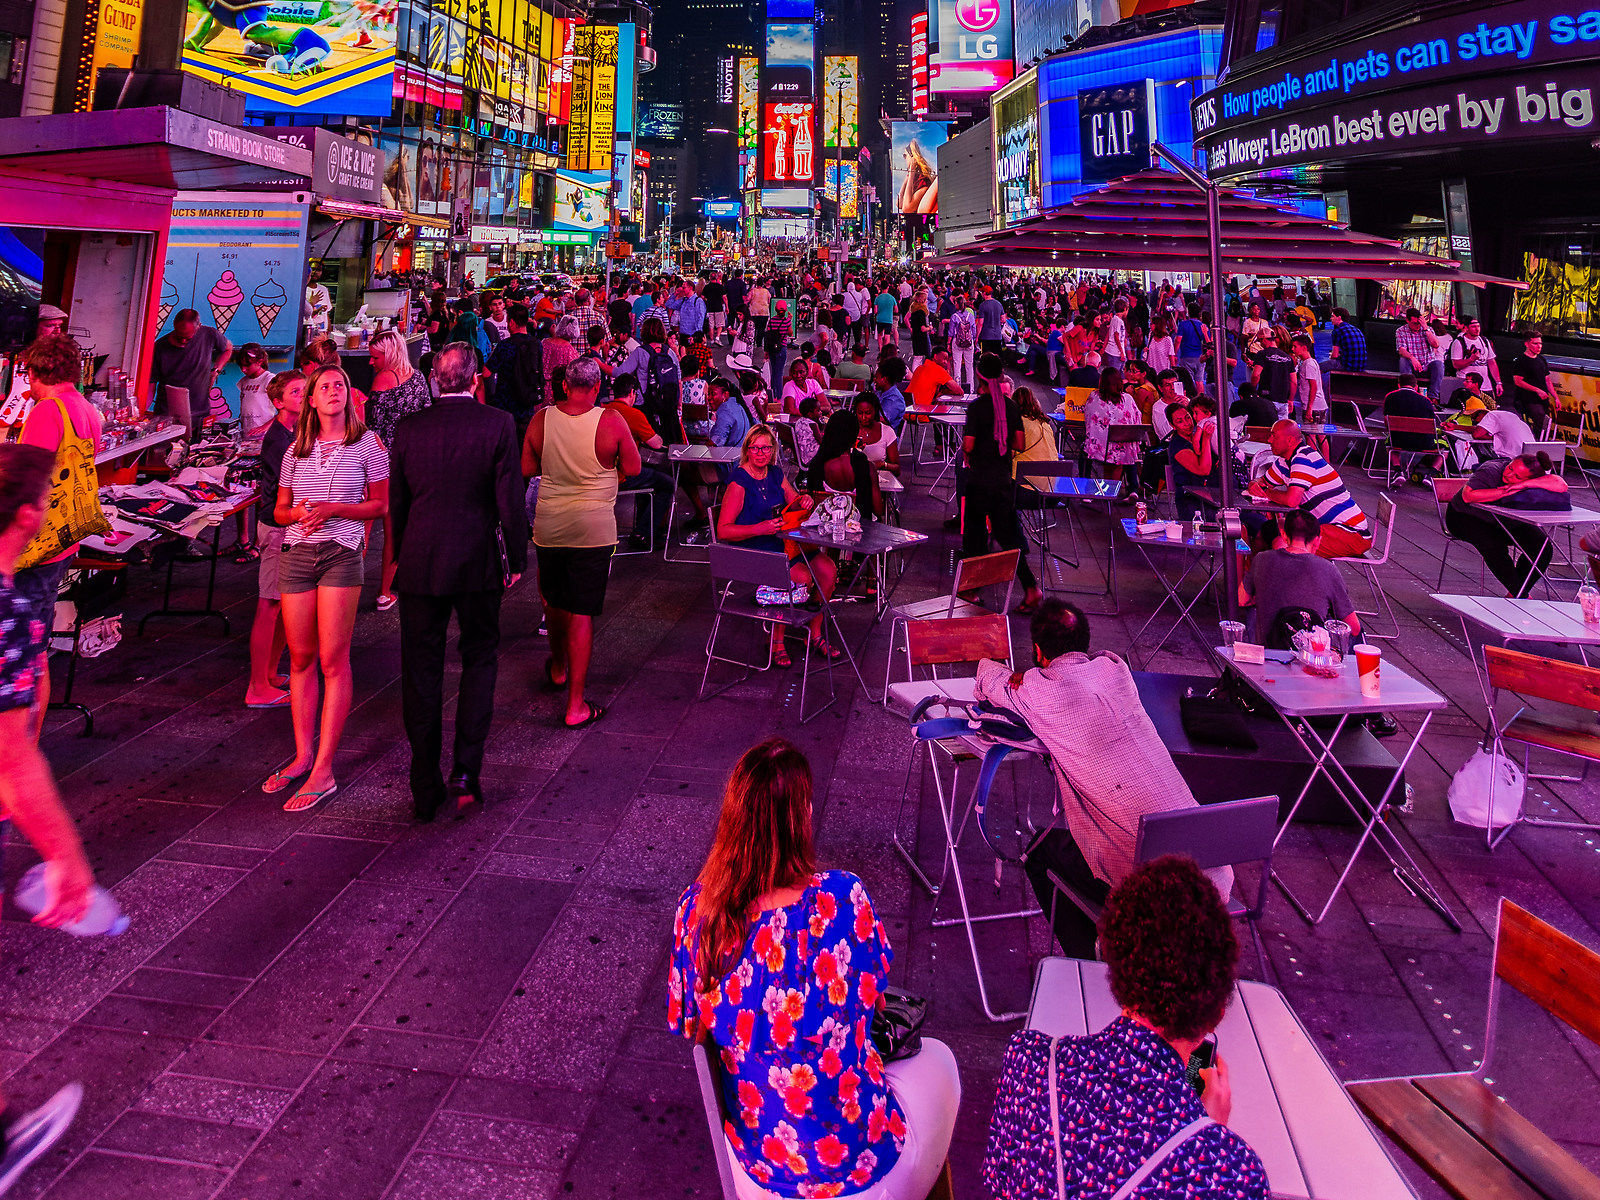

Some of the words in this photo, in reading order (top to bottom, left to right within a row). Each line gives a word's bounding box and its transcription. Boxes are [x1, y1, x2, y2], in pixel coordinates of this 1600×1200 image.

[104, 4, 137, 31] GUMP
[266, 5, 315, 16] obile
[99, 40, 134, 54] COMPANY
[104, 32, 131, 44] SHRIMP
[959, 34, 998, 59] LG
[1223, 91, 1250, 119] How
[1252, 72, 1301, 117] people
[1304, 58, 1339, 96] and
[1342, 50, 1391, 93] pets
[1395, 38, 1451, 73] can
[1456, 20, 1539, 60] stay
[1549, 9, 1600, 45] sa
[723, 55, 735, 104] NOVOTEL
[648, 108, 684, 122] FROZEN
[1229, 137, 1269, 166] Morey:
[1270, 123, 1331, 157] LeBron
[1333, 109, 1384, 146] best
[1388, 104, 1450, 138] ever
[1457, 93, 1505, 135] by
[1516, 81, 1595, 128] big
[207, 128, 241, 154] STRAND
[242, 138, 263, 159] BOOK
[263, 144, 286, 165] STORE
[1092, 109, 1135, 157] GAP
[340, 145, 353, 171] ICE
[353, 149, 360, 172] &
[360, 151, 376, 176] VICE
[997, 155, 1010, 184] OLD
[1009, 149, 1028, 181] NAVY
[199, 209, 250, 218] MARKETED
[252, 209, 264, 218] TO
